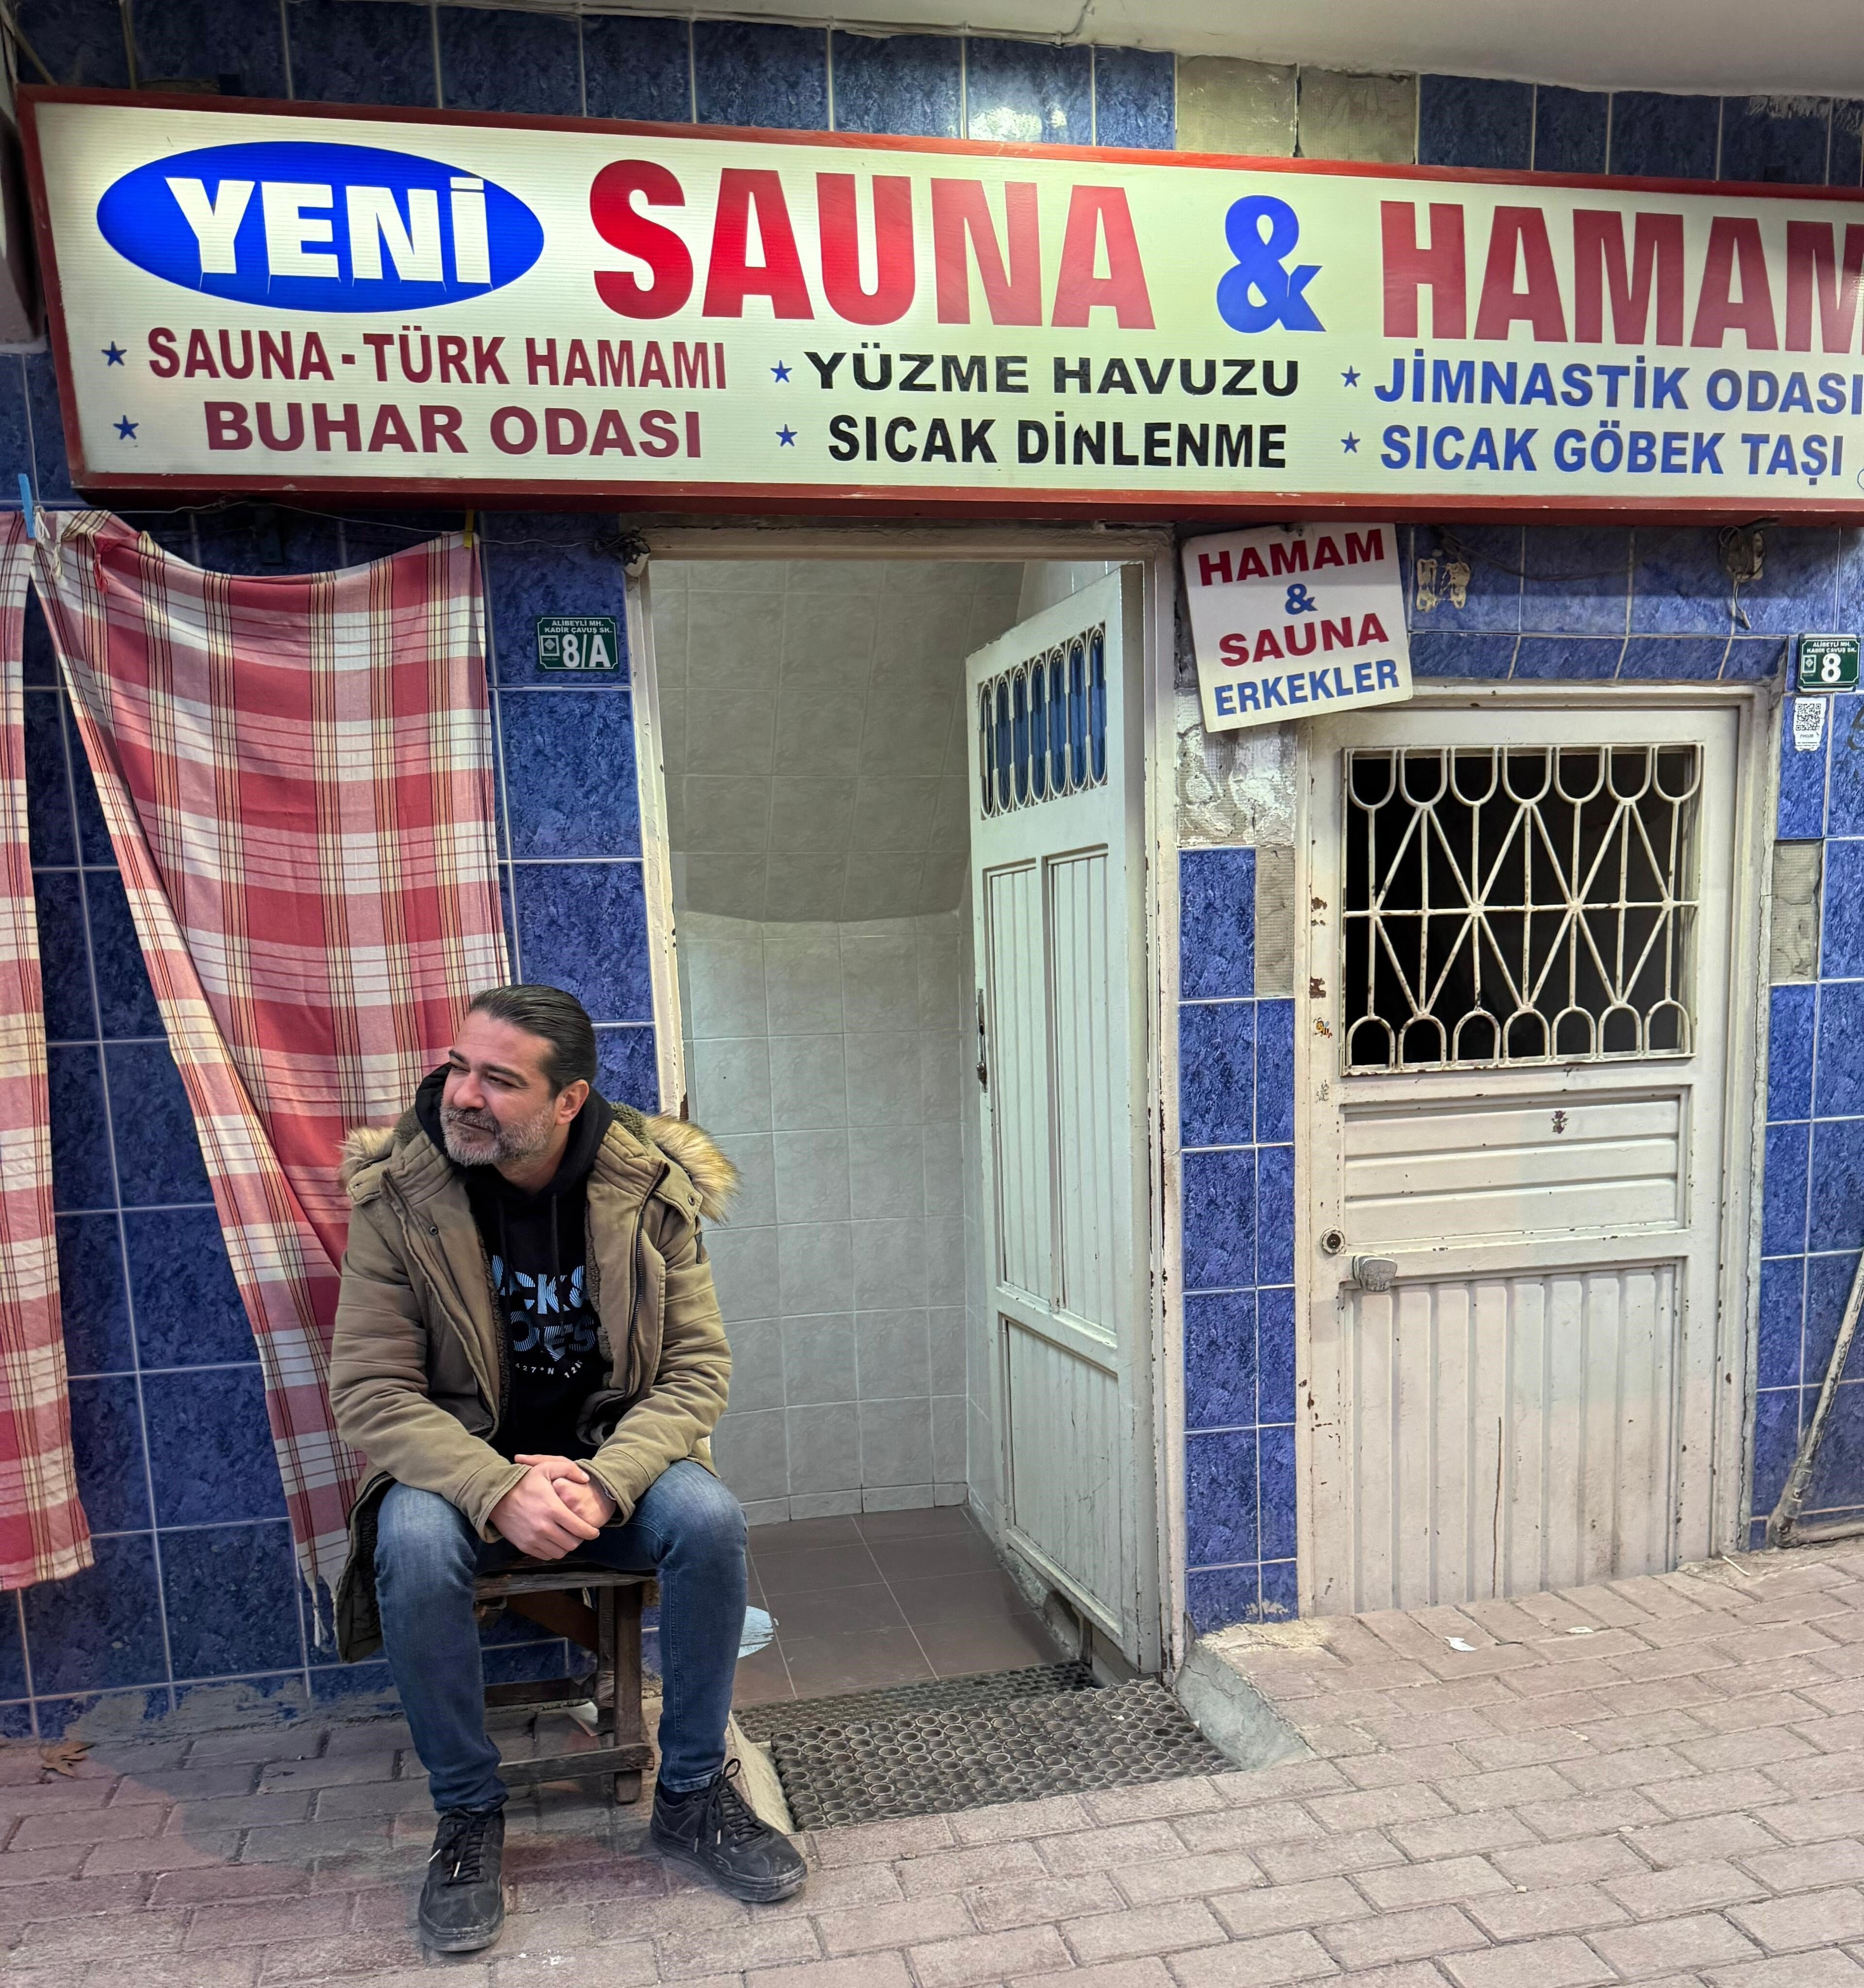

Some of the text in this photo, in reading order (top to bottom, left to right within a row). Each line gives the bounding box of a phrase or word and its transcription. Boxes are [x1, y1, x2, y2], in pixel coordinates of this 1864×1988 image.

[166, 177, 493, 284] YENİ
[590, 158, 1864, 355] SAUNA & HAMAM
[526, 337, 727, 389] HAMAMI
[803, 342, 1298, 397] YÜZME HAVUZU
[1374, 348, 1864, 415] JİMNASTİK ODASI
[203, 401, 701, 459] BUHAR ODASI
[828, 410, 1287, 468] SICAK DİNLENME
[1380, 420, 1843, 486] SICAK GÖBEK TAŞI
[1198, 528, 1385, 587] HAMAM
[1284, 583, 1318, 615] &
[562, 634, 612, 668] 8/A
[1219, 613, 1390, 667] SAUNA
[1821, 653, 1841, 682] 8
[1214, 659, 1400, 717] ERKEKLER
